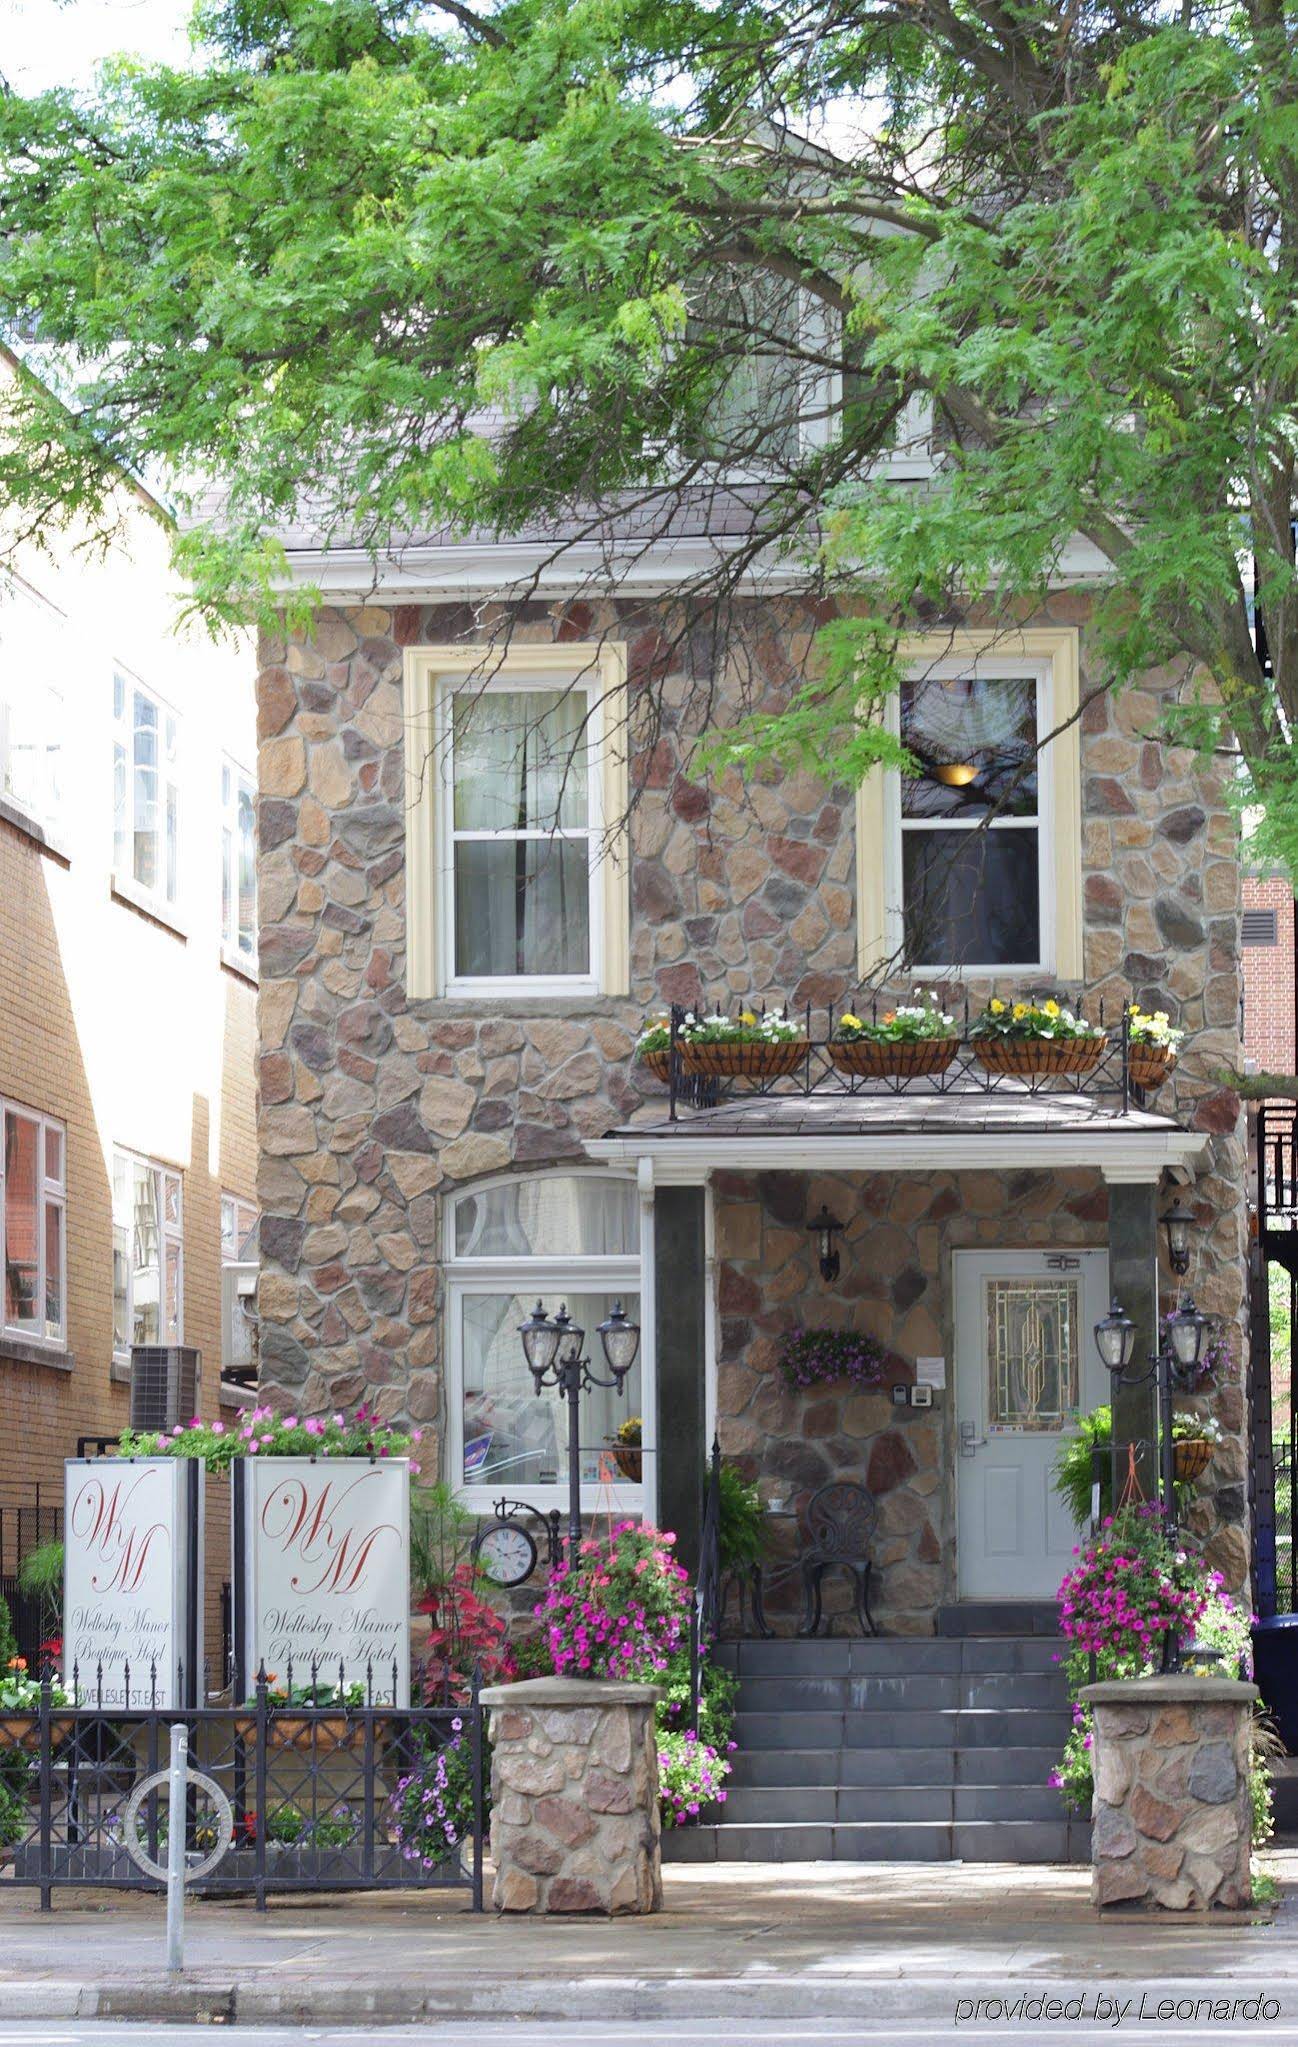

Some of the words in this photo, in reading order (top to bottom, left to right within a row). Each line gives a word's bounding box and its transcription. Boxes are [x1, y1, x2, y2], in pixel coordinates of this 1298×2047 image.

[71, 1603, 121, 1643] Wellesley
[125, 1607, 169, 1633] Manor
[263, 1605, 333, 1643] Wellesley
[338, 1607, 402, 1633] Manor
[74, 1635, 128, 1672] Boutique
[129, 1635, 166, 1661] Hotel
[268, 1639, 341, 1671] Boutique
[345, 1637, 397, 1661] Hotel
[83, 1687, 130, 1705] WELESLE
